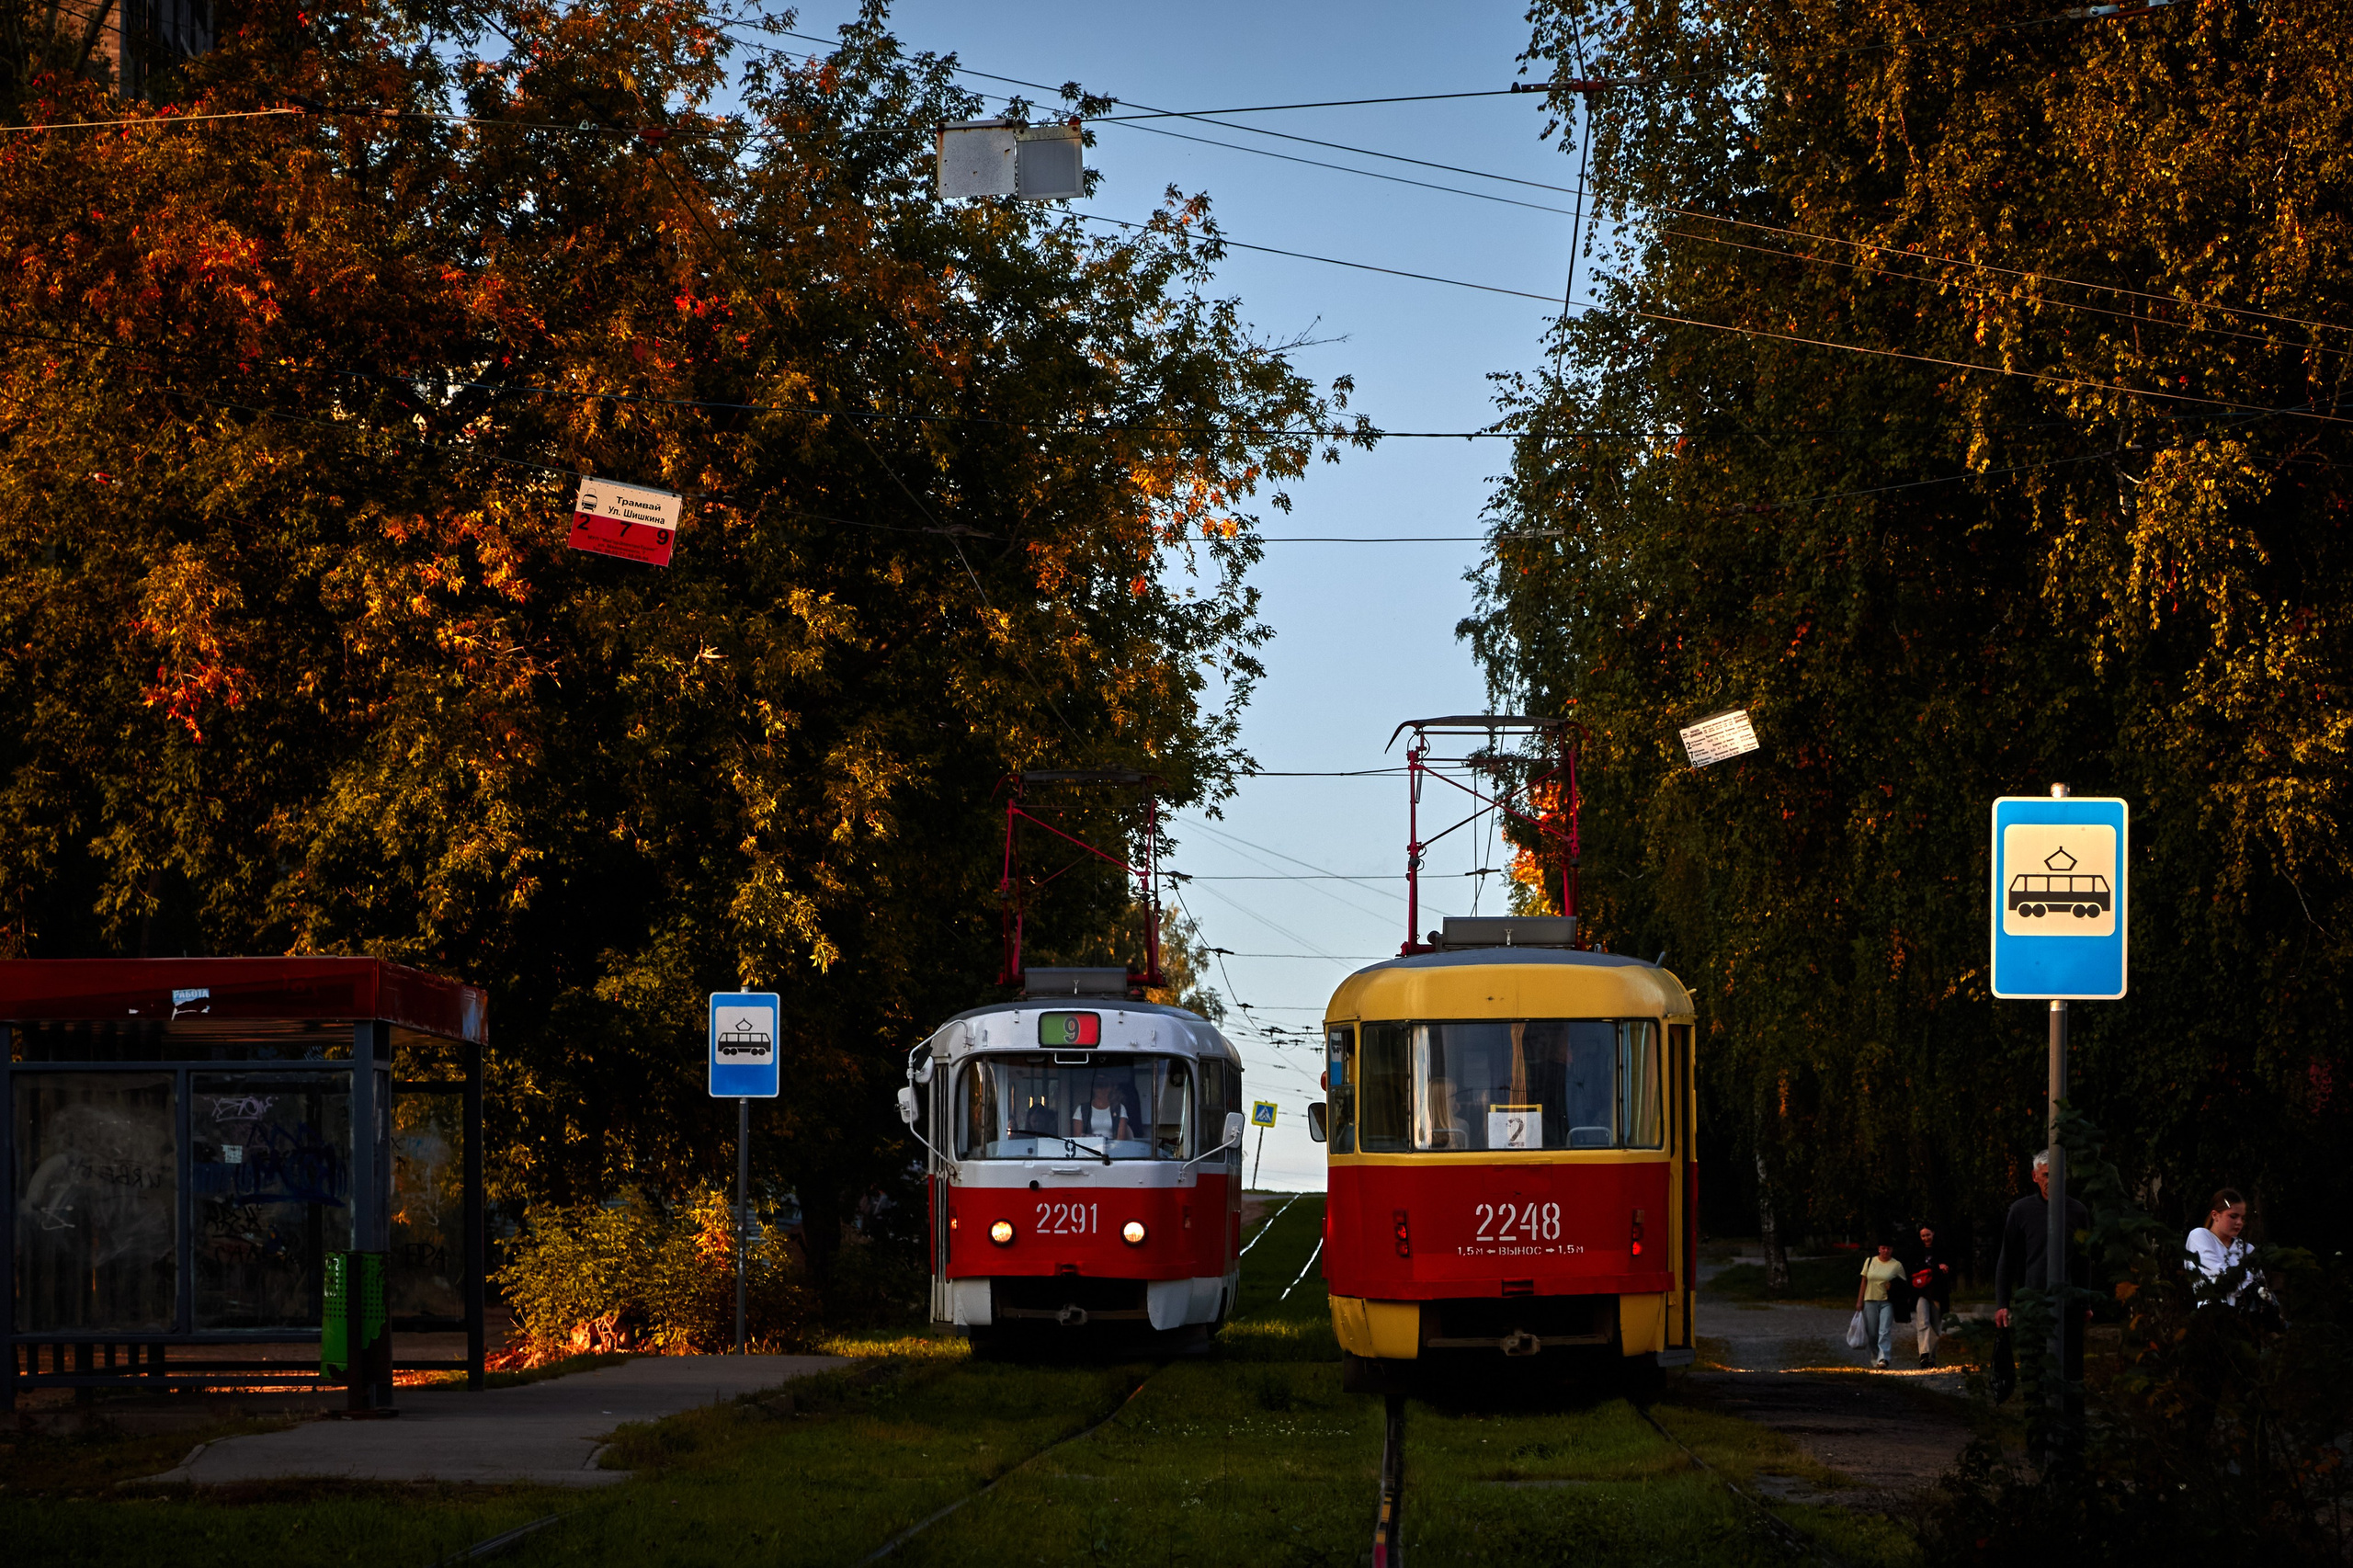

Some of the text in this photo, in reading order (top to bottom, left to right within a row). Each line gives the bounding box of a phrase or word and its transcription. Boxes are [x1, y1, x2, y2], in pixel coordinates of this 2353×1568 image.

[608, 506, 665, 525] Ул. Шишкина
[616, 496, 662, 512] Трамвай
[577, 514, 669, 545] 2 7 9
[1063, 1017, 1080, 1044] 9
[1506, 1118, 1525, 1147] 2
[1064, 1139, 1076, 1158] 9
[1036, 1202, 1097, 1234] 2291
[1475, 1202, 1561, 1242] 2248
[1498, 1246, 1541, 1256] ВЫНОС
